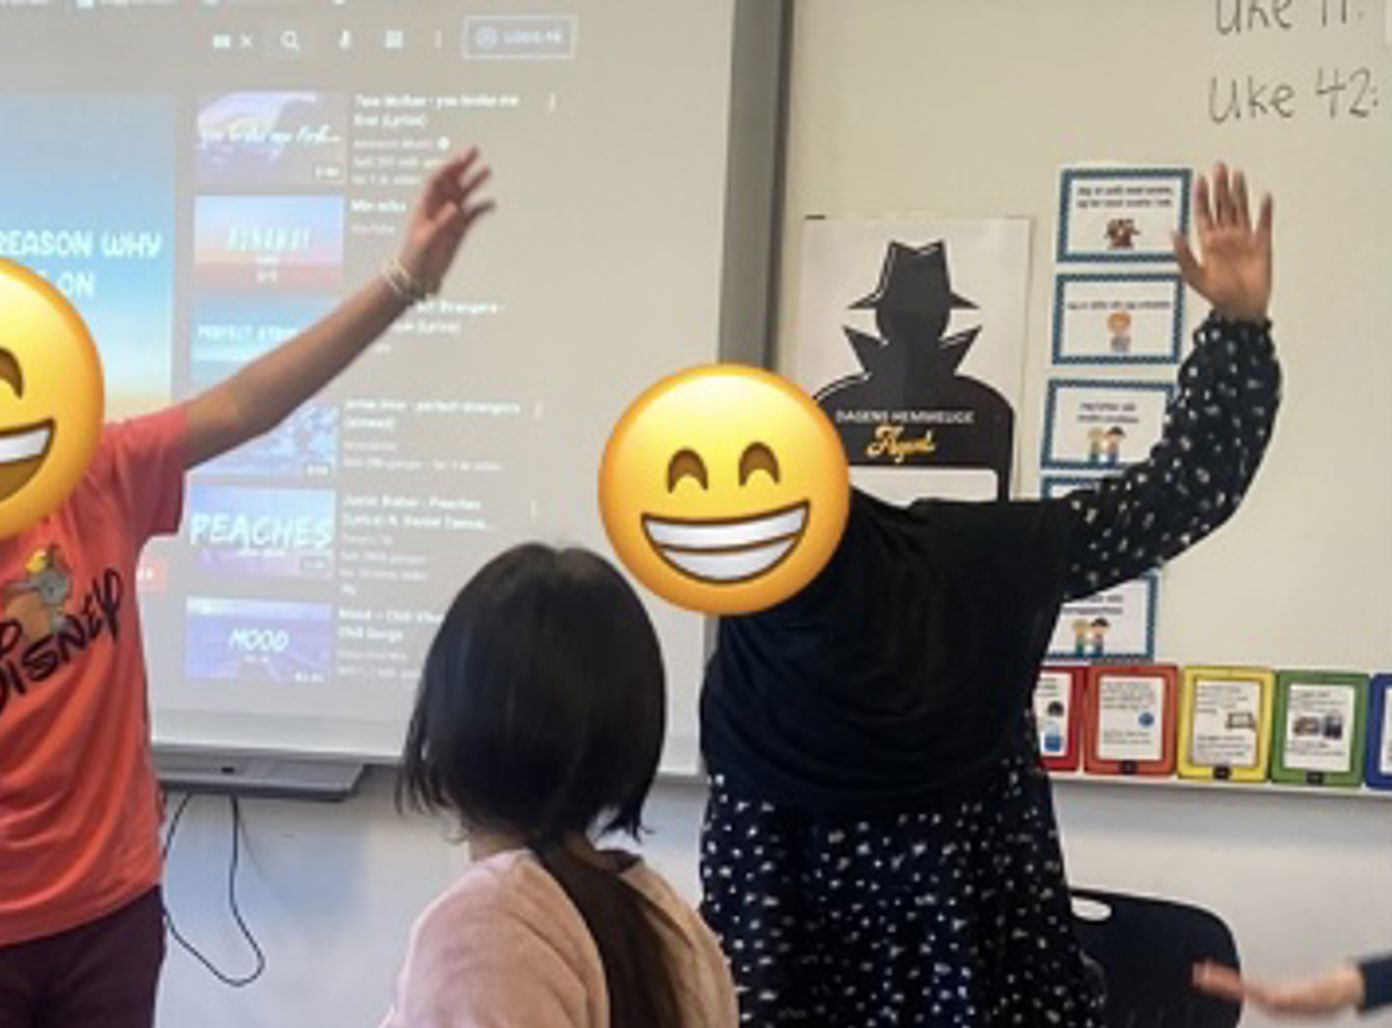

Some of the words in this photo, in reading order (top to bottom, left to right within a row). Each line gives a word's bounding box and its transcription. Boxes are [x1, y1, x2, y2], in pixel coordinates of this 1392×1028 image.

[1209, 74, 1295, 125] Uke
[101, 231, 164, 259] WHY
[190, 512, 333, 550] PEACHES
[229, 627, 291, 653] MOOD
